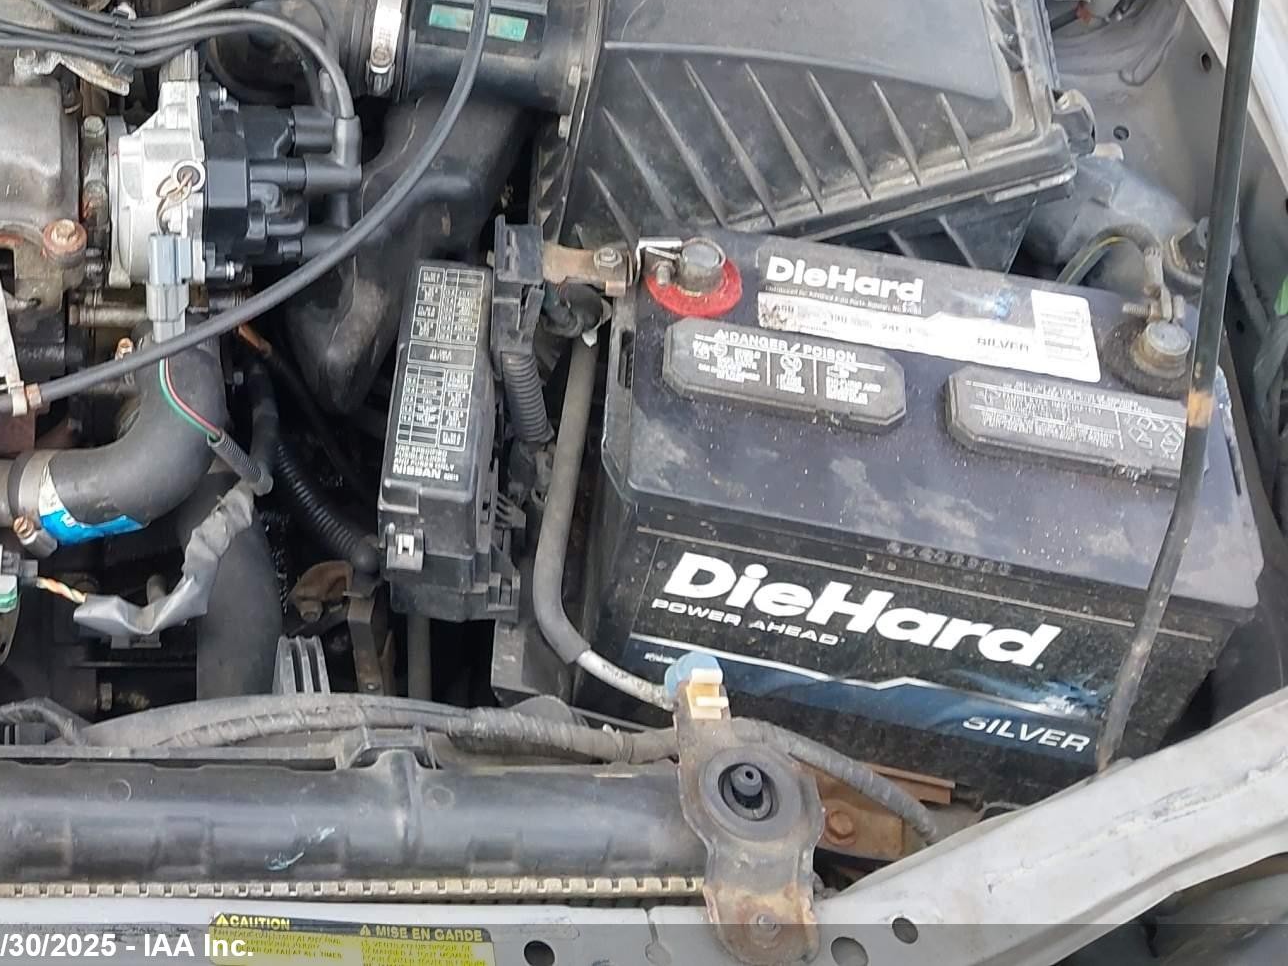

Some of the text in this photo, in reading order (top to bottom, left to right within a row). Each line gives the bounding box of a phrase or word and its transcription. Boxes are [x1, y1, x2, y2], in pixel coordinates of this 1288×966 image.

[766, 255, 924, 303] DieHard
[730, 331, 788, 353] DANGER
[803, 344, 856, 363] POISON
[392, 465, 441, 480] NISSAN
[651, 599, 840, 646] POWER AHEAD
[663, 551, 1062, 667] DieHard
[962, 715, 1091, 753] SILVER
[229, 914, 290, 931] CAUTION
[375, 924, 483, 943] MISE EN GARDE
